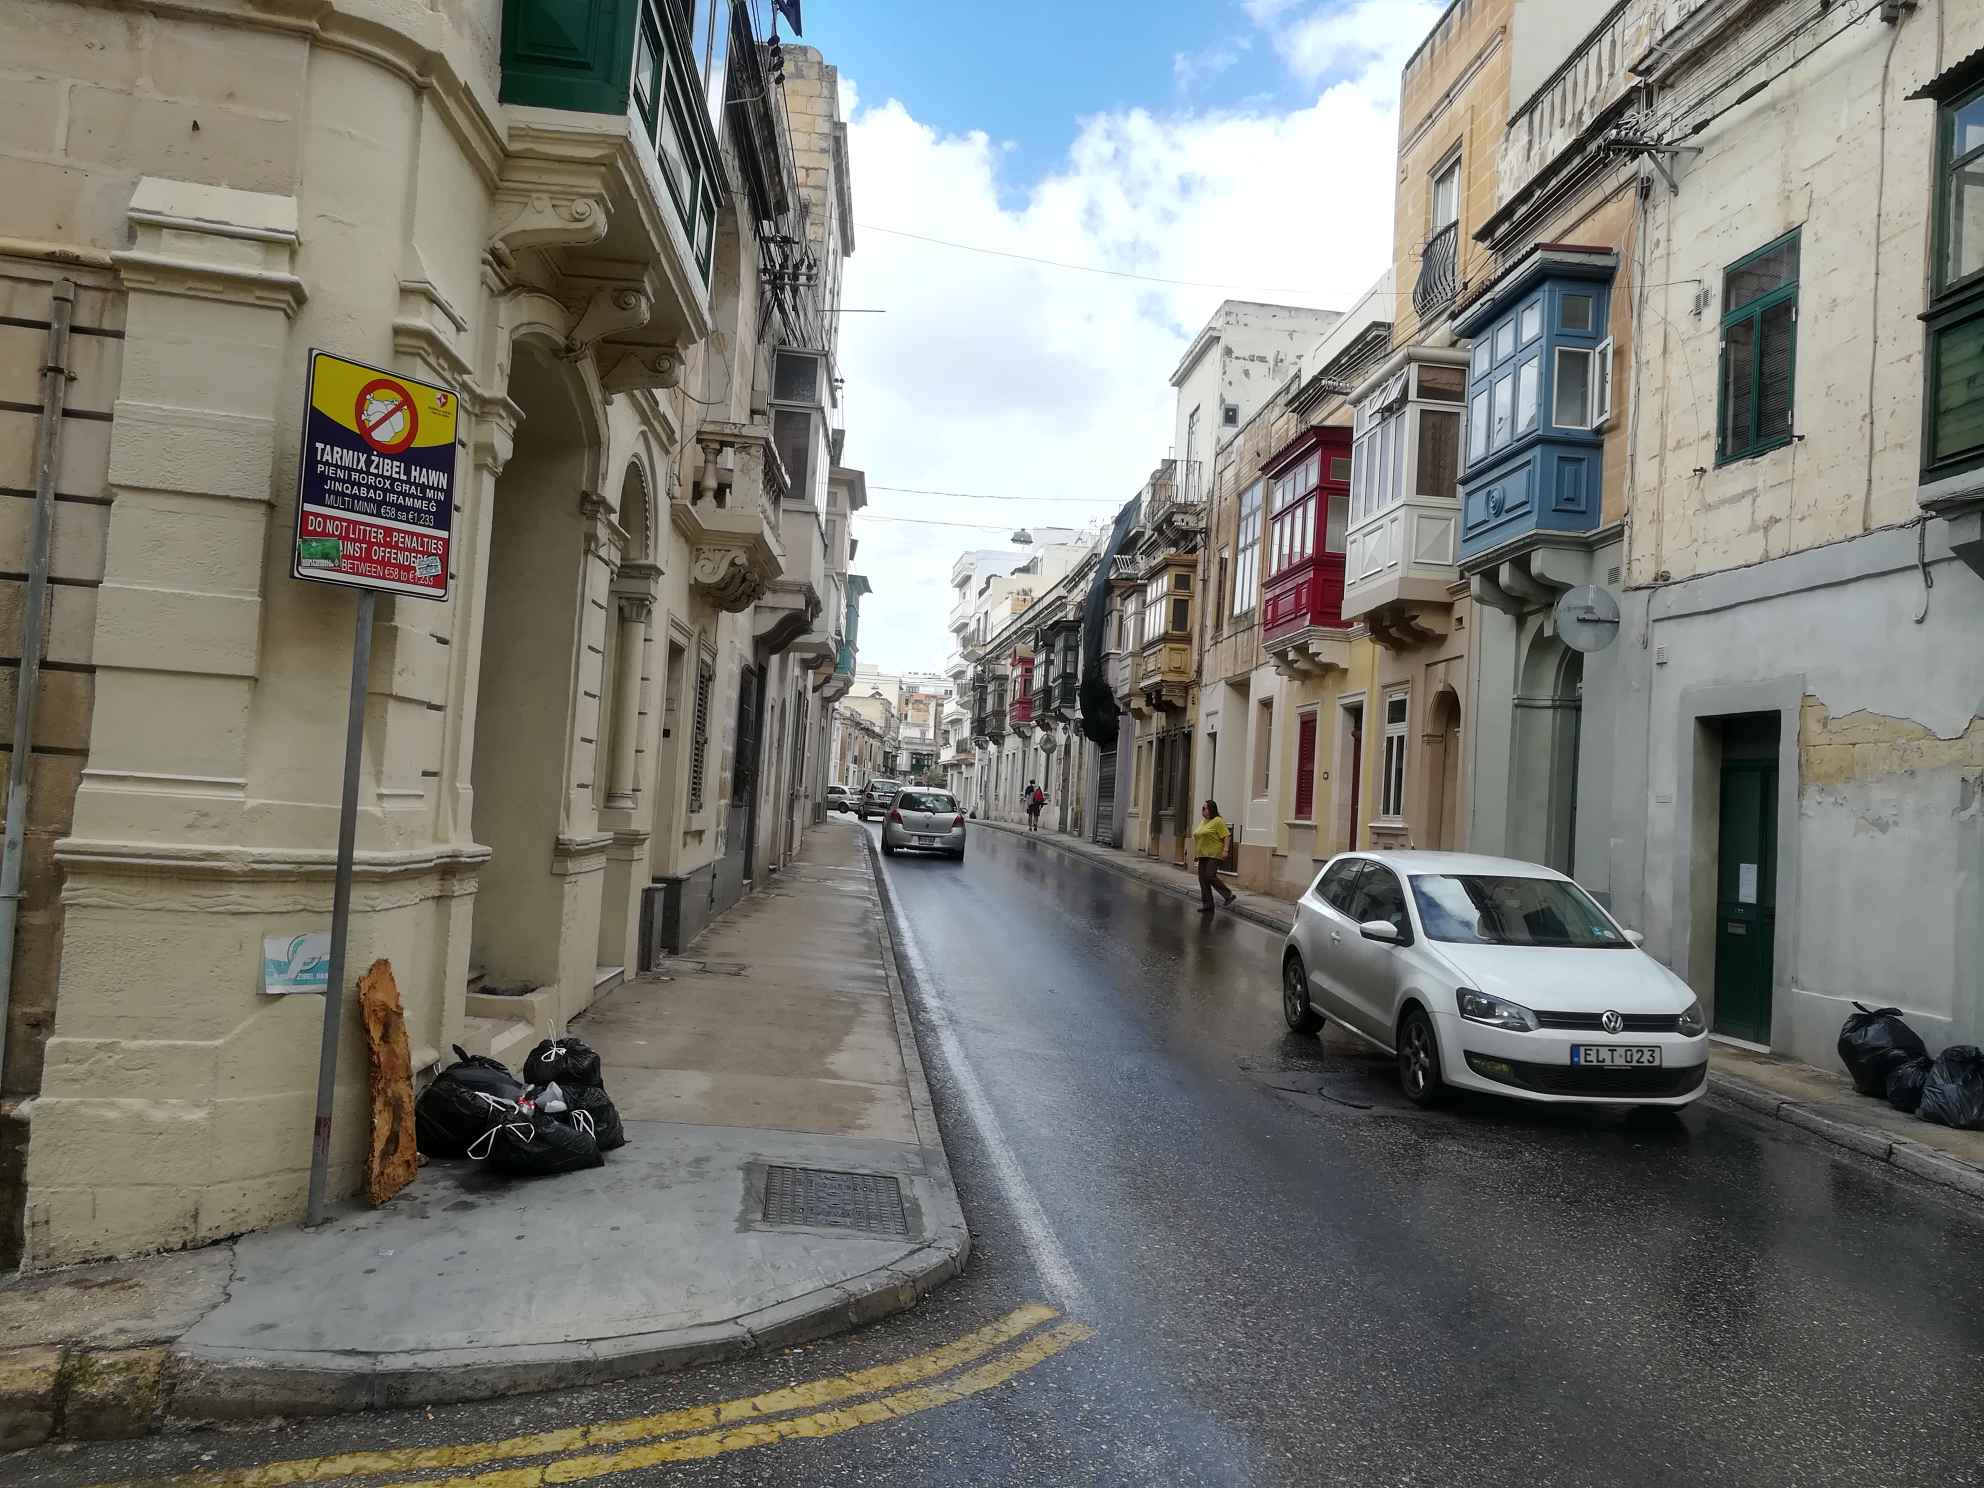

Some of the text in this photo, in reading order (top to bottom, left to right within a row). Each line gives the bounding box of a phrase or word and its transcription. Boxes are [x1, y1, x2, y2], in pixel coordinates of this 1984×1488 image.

[315, 442, 448, 490] TARMIX ŻIBEL HAWN
[317, 464, 348, 480] PIENI
[425, 489, 445, 501] MIN
[324, 479, 383, 500] JINQABAD
[324, 493, 352, 509] MULTI
[353, 500, 377, 515] MINN
[380, 505, 396, 518] €58
[396, 511, 407, 521] sa
[308, 516, 323, 531] DO
[326, 519, 347, 537] NOT
[350, 523, 385, 543] LITTER
[392, 531, 443, 554] PENALTIES
[341, 559, 384, 577] BETWEEN
[385, 566, 399, 580] €58
[400, 569, 408, 581] to
[1583, 1048, 1656, 1064] ELT 023
